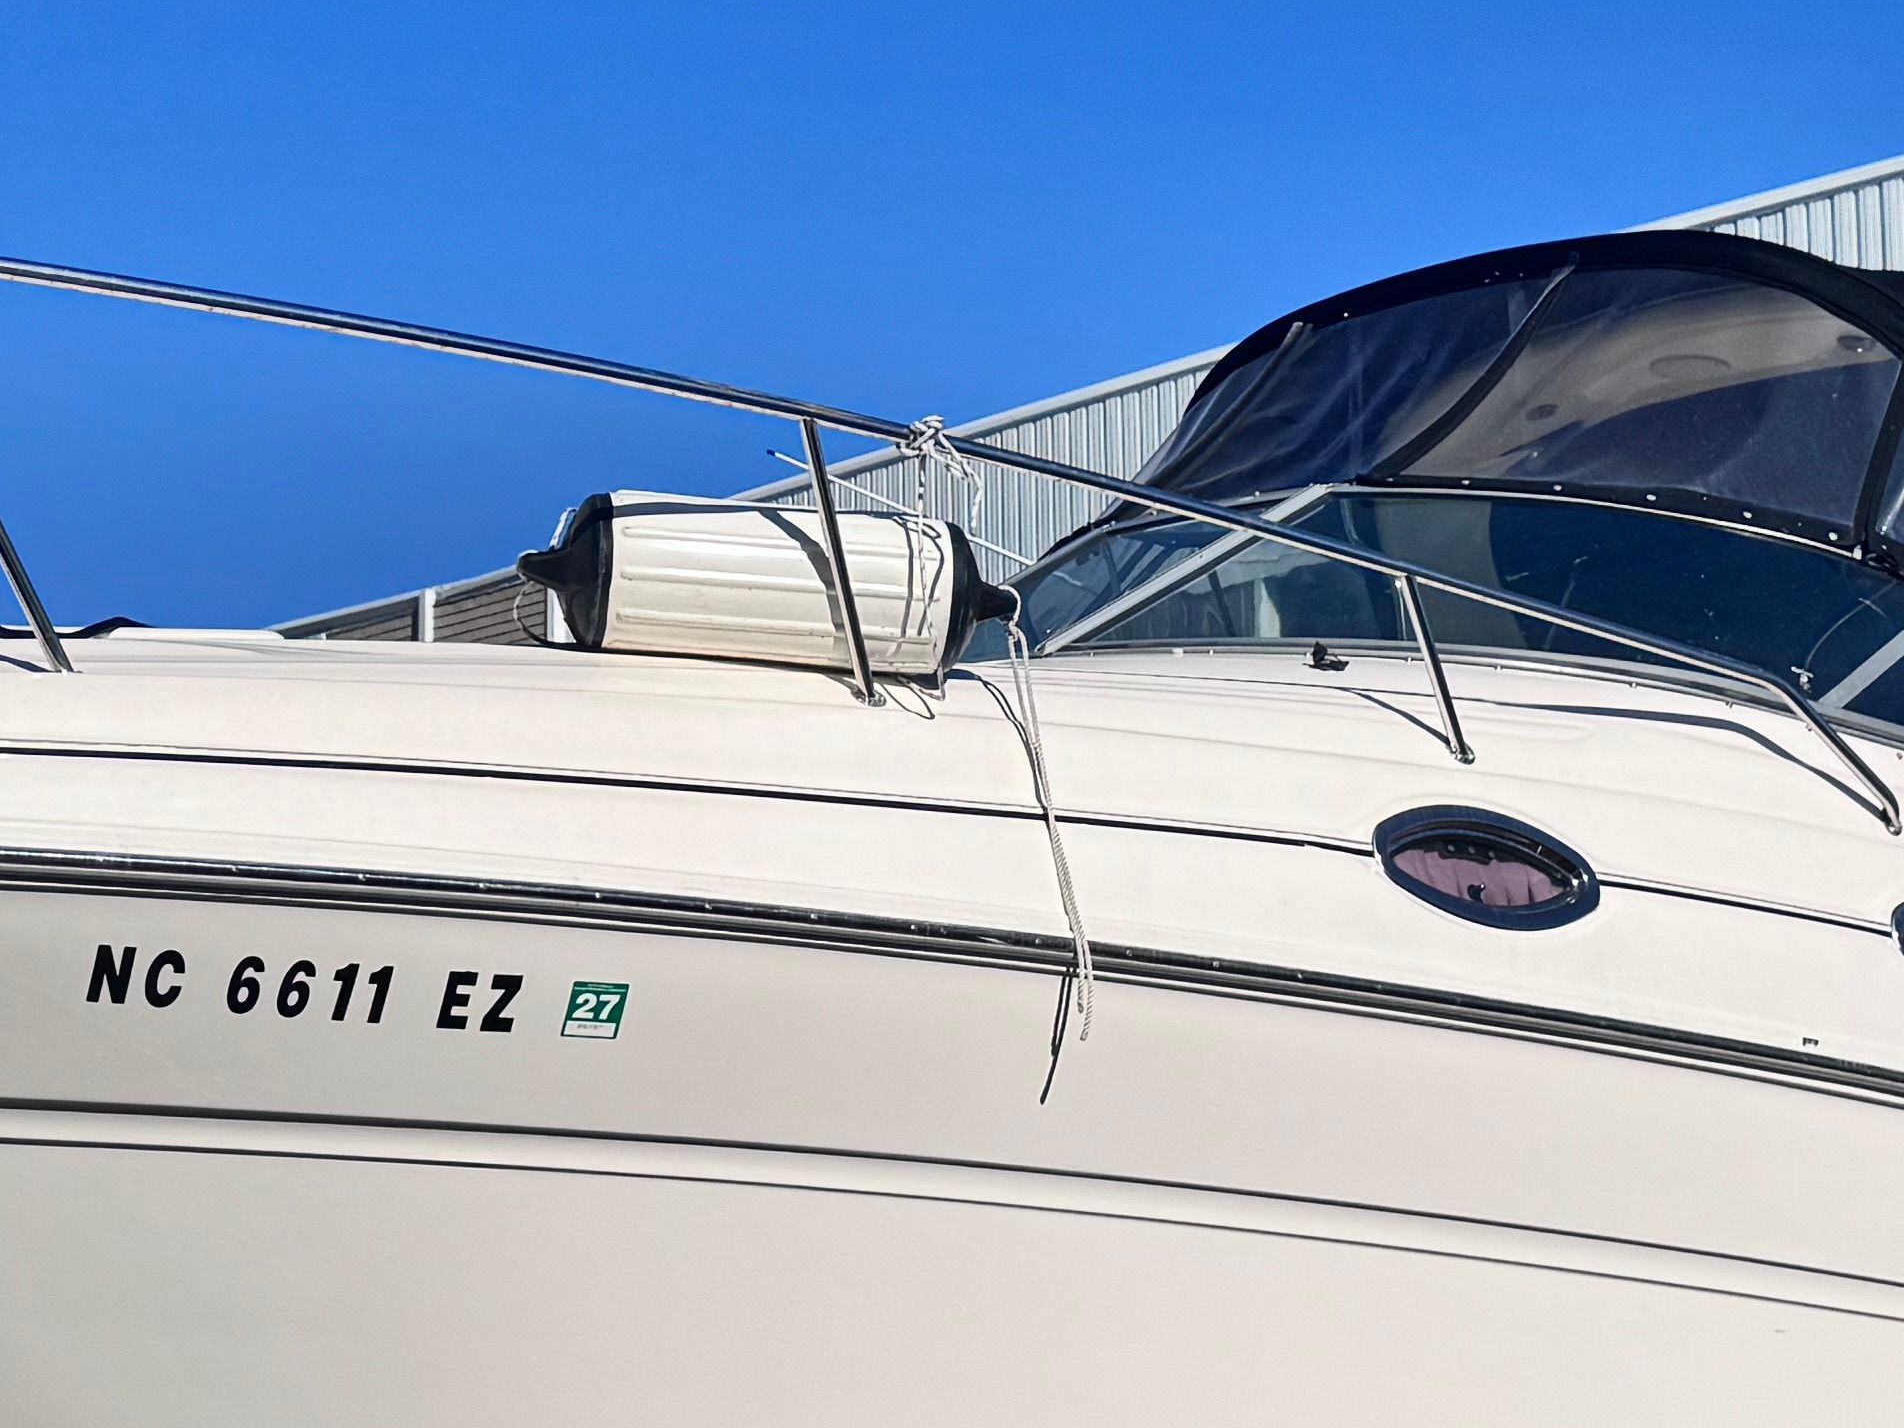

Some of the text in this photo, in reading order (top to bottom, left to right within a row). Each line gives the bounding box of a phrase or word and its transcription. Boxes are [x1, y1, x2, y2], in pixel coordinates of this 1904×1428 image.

[85, 943, 525, 1033] NC 6611 EZ
[571, 992, 622, 1021] 27
